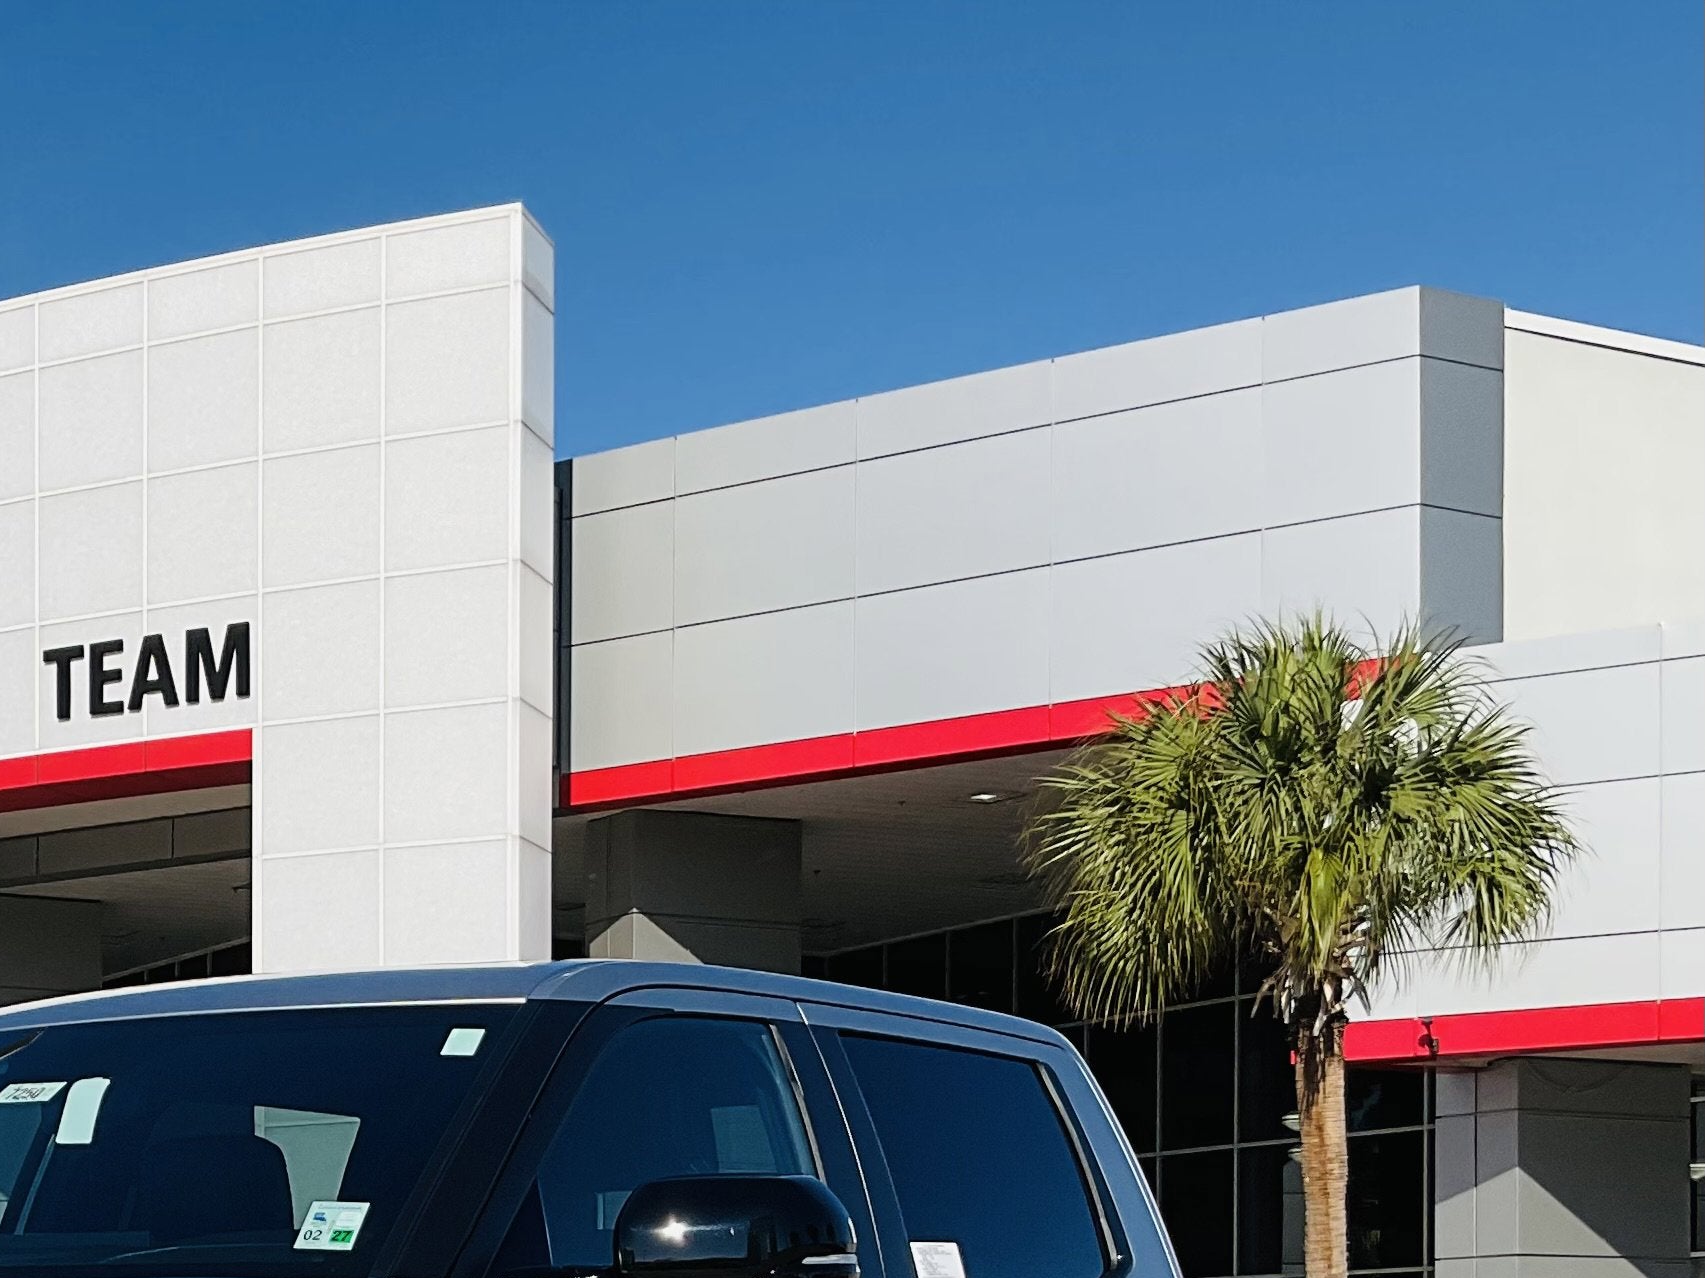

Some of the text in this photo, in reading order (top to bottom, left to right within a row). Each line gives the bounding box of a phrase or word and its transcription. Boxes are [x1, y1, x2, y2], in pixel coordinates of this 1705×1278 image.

[43, 621, 250, 720] TEAM
[303, 1229, 353, 1242] 02 27
